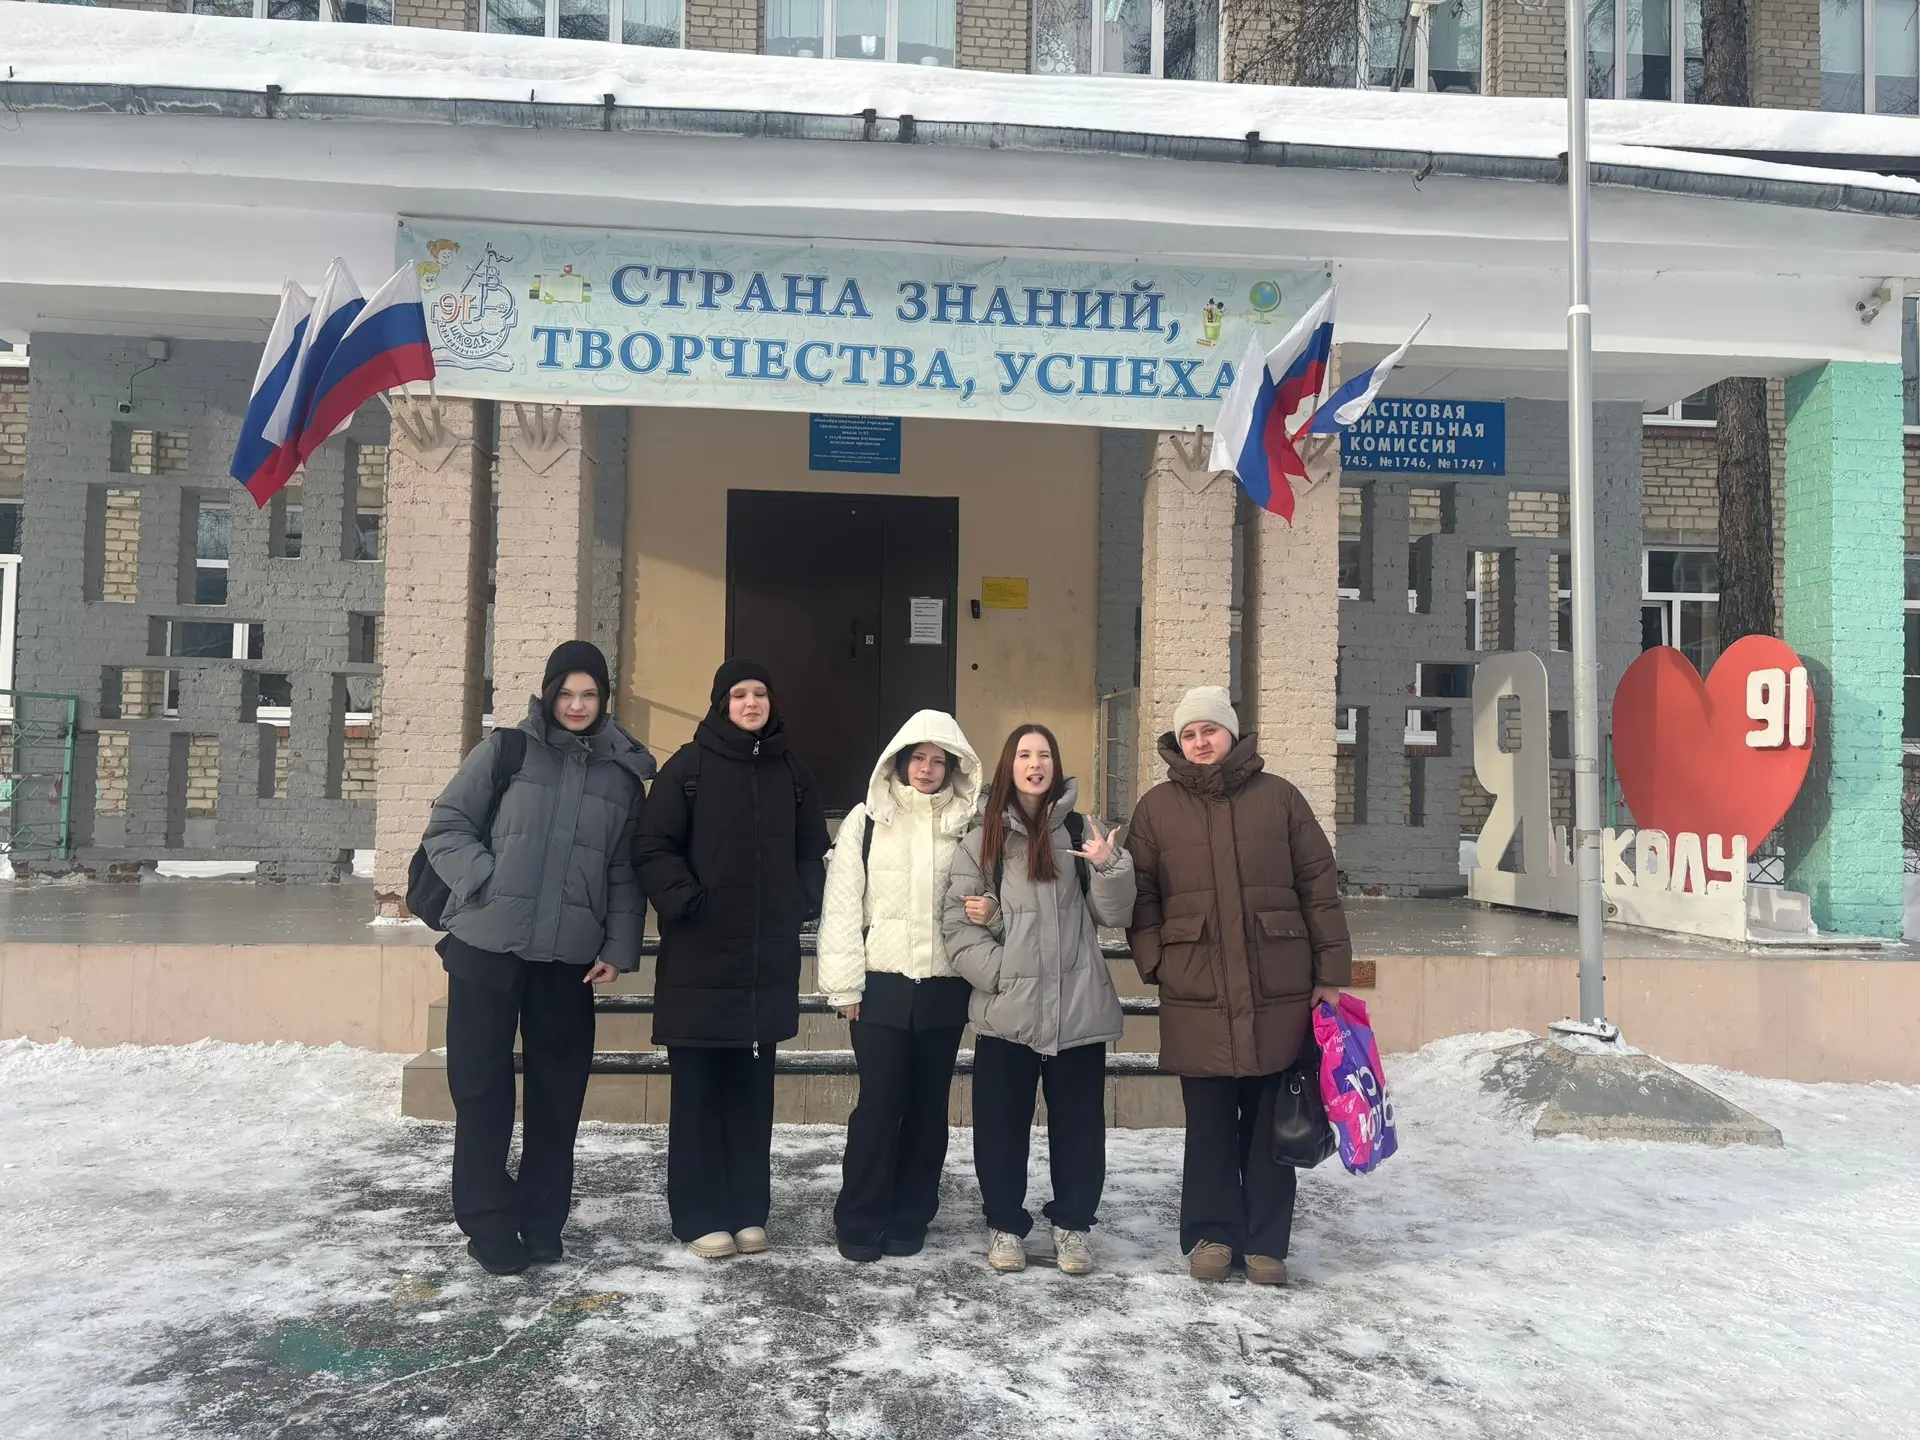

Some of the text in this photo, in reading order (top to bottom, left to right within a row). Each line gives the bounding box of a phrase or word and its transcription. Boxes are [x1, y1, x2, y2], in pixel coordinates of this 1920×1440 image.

[611, 264, 1181, 344] СТРАНА ЗНАНИЙ,
[450, 325, 493, 350] ШКОЛА
[531, 326, 1236, 401] ТВОРЧЕСТВА, УСПЕХА
[1366, 402, 1465, 419] АСТКОВАЯ
[1348, 419, 1485, 438] БИРАТЕЛЬНАЯ
[1350, 436, 1456, 454] КОМИССИЯ
[1344, 455, 1485, 470] 745, №1746, №1747
[1745, 667, 1808, 748] 91
[1472, 650, 1551, 874] Я
